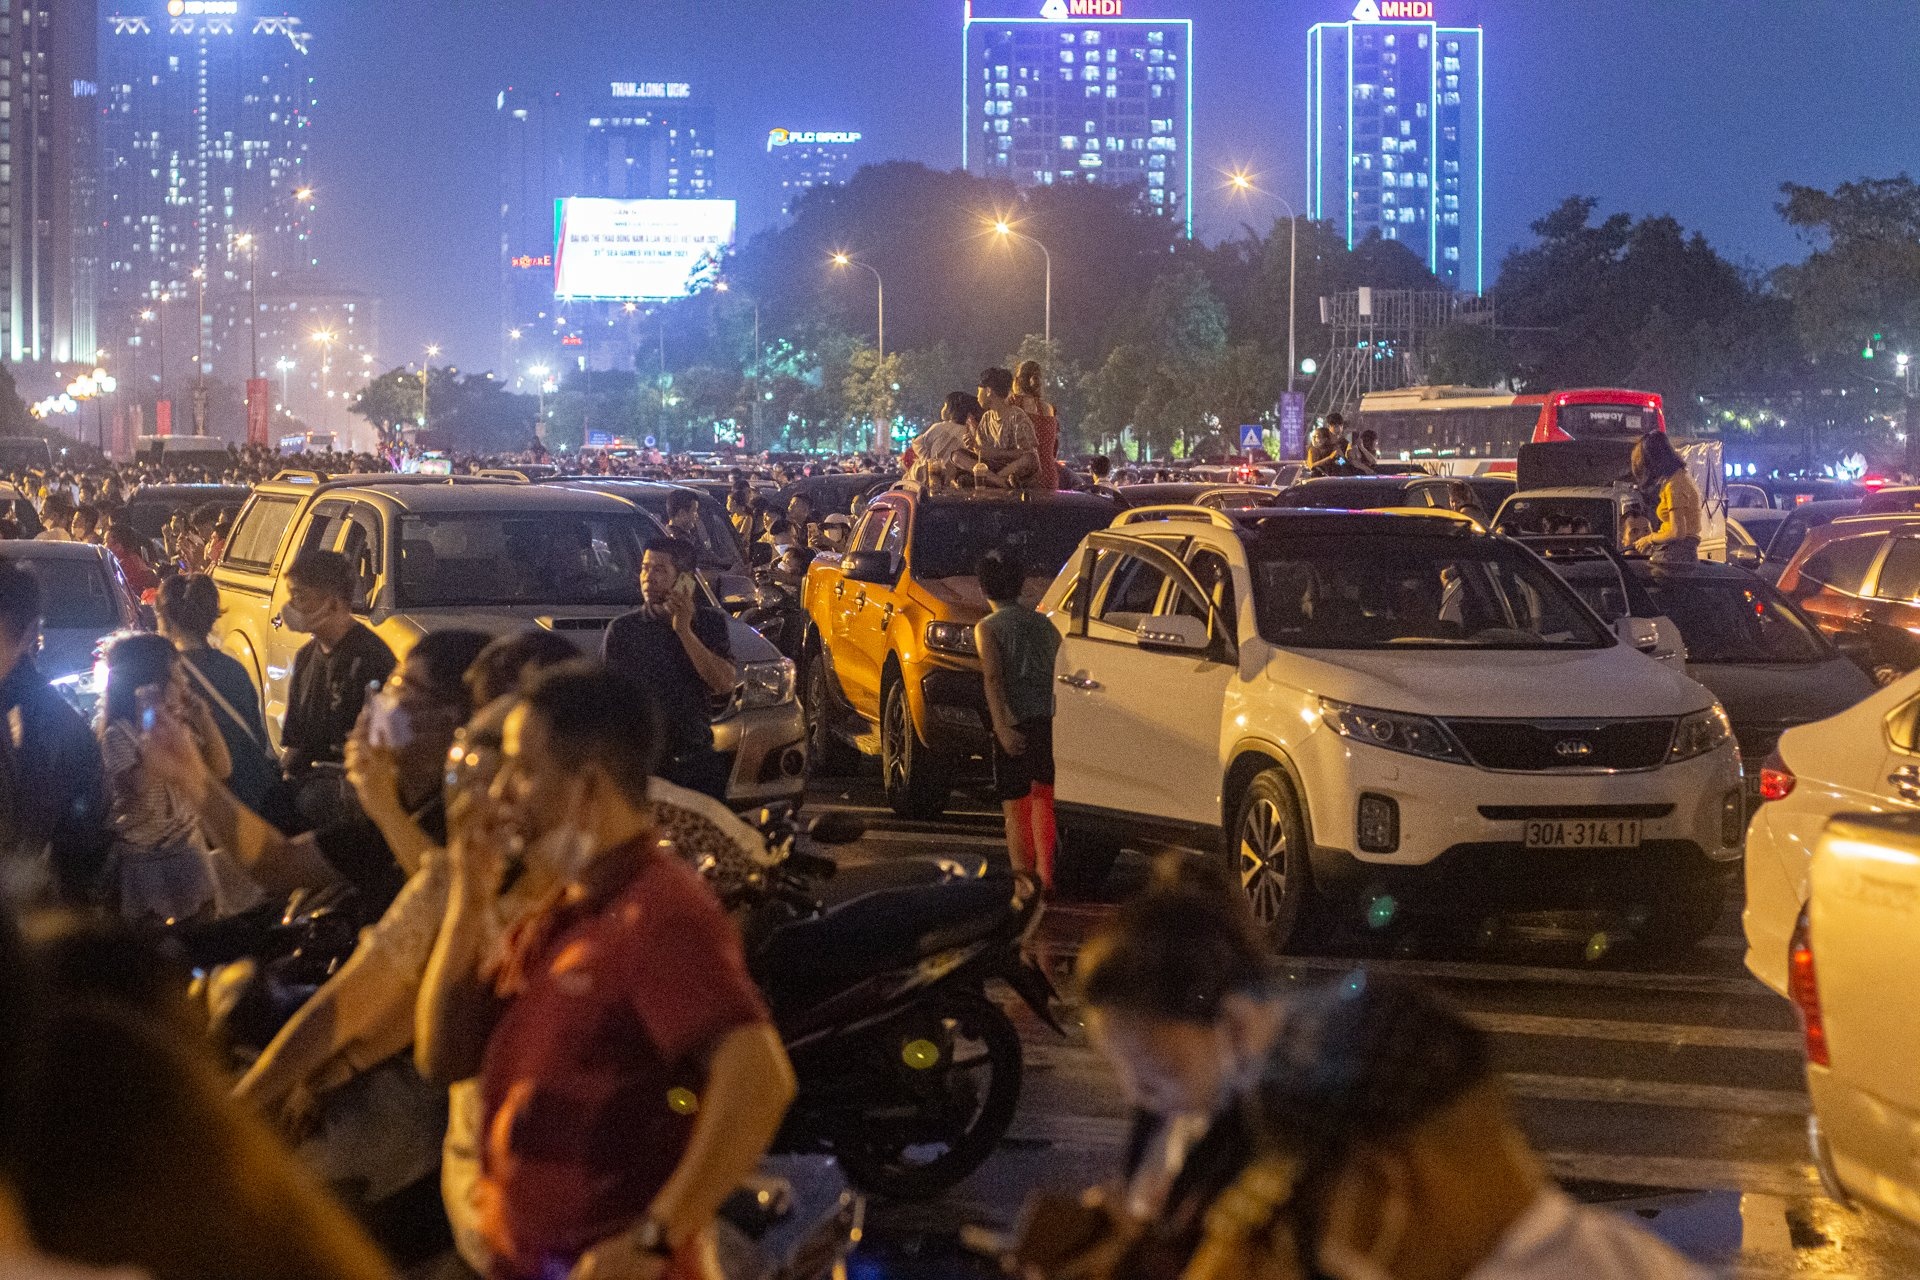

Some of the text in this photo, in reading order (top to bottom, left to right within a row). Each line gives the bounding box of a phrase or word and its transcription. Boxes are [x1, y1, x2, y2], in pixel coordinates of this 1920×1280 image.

[1069, 0, 1122, 15] MHDI
[1381, 1, 1433, 17] MHDI
[816, 132, 862, 143] GROUP
[1529, 822, 1636, 846] 30A-314.11
